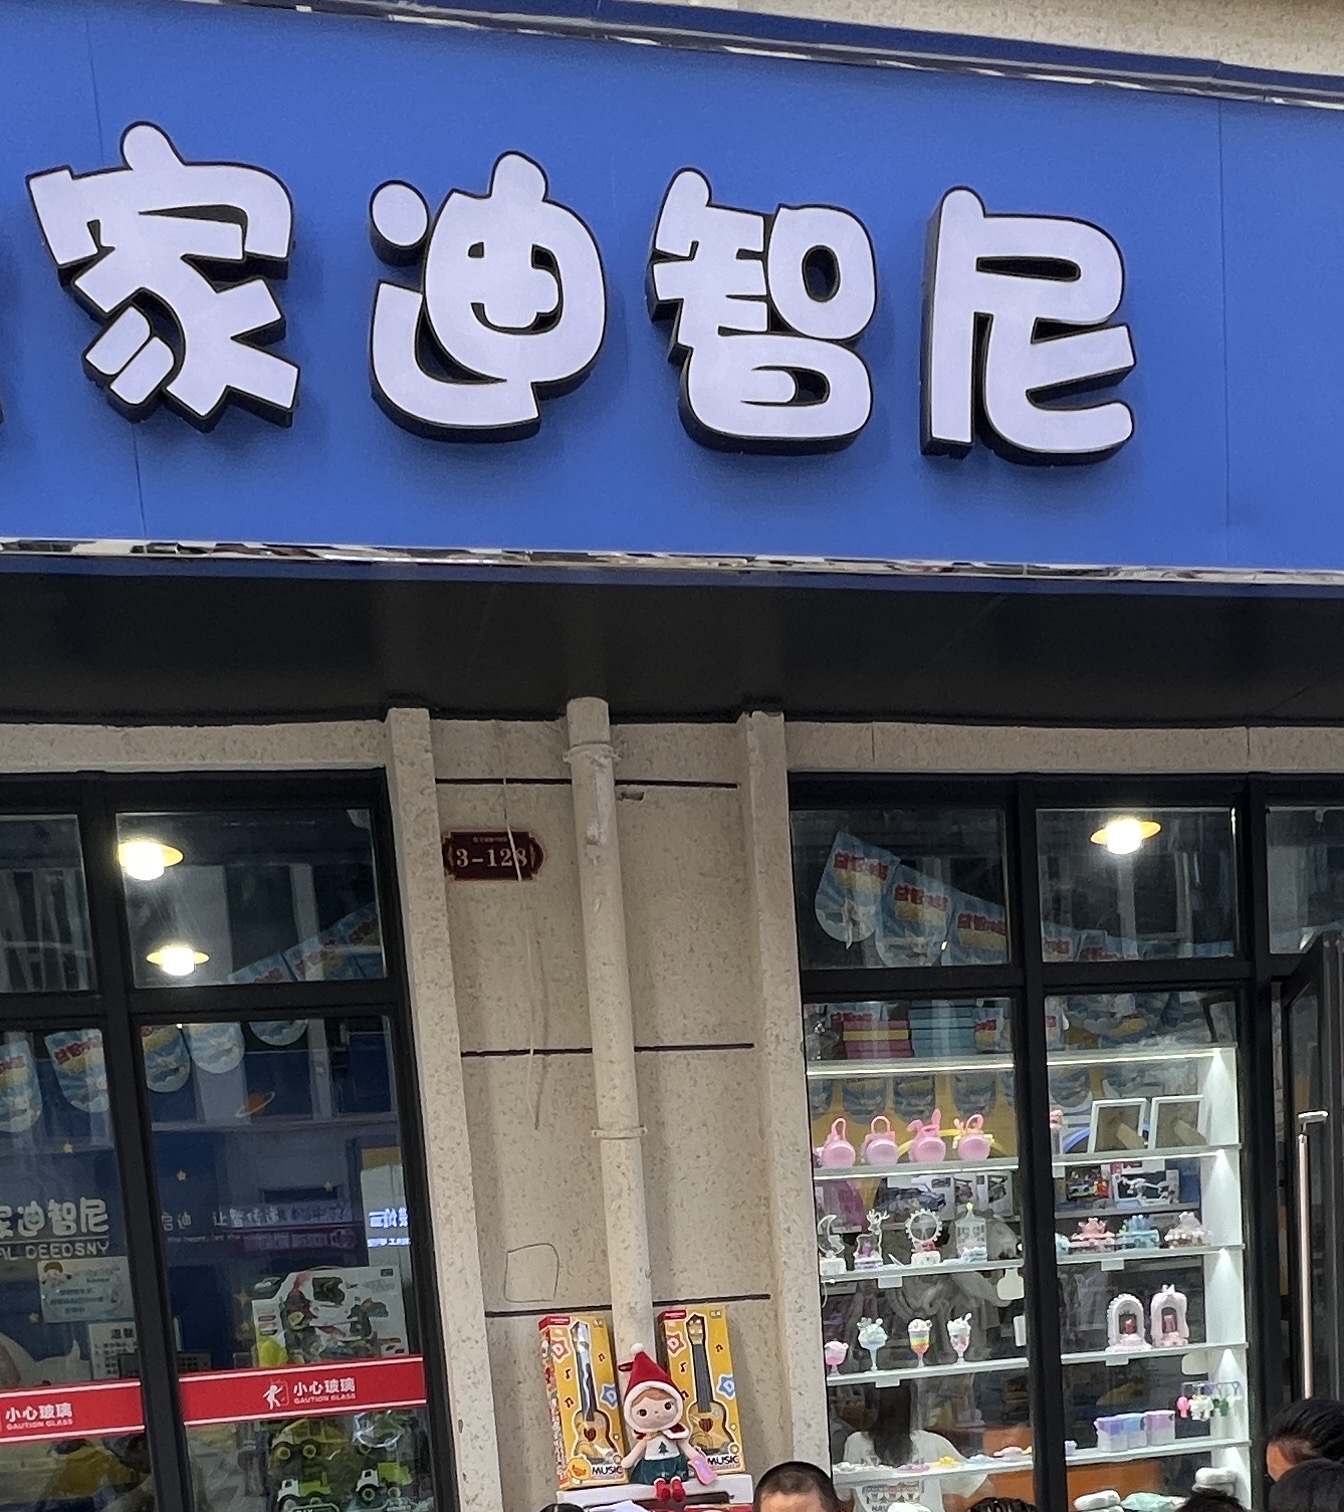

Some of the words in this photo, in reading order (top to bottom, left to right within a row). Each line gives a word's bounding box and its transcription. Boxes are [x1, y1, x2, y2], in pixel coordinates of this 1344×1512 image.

[455, 847, 528, 868] 3-128
[294, 1376, 356, 1397] 小心玻璃
[5, 1402, 73, 1423] 小心玻璃
[592, 1465, 623, 1475] MUSIC
[707, 1455, 740, 1465] MUSIC
